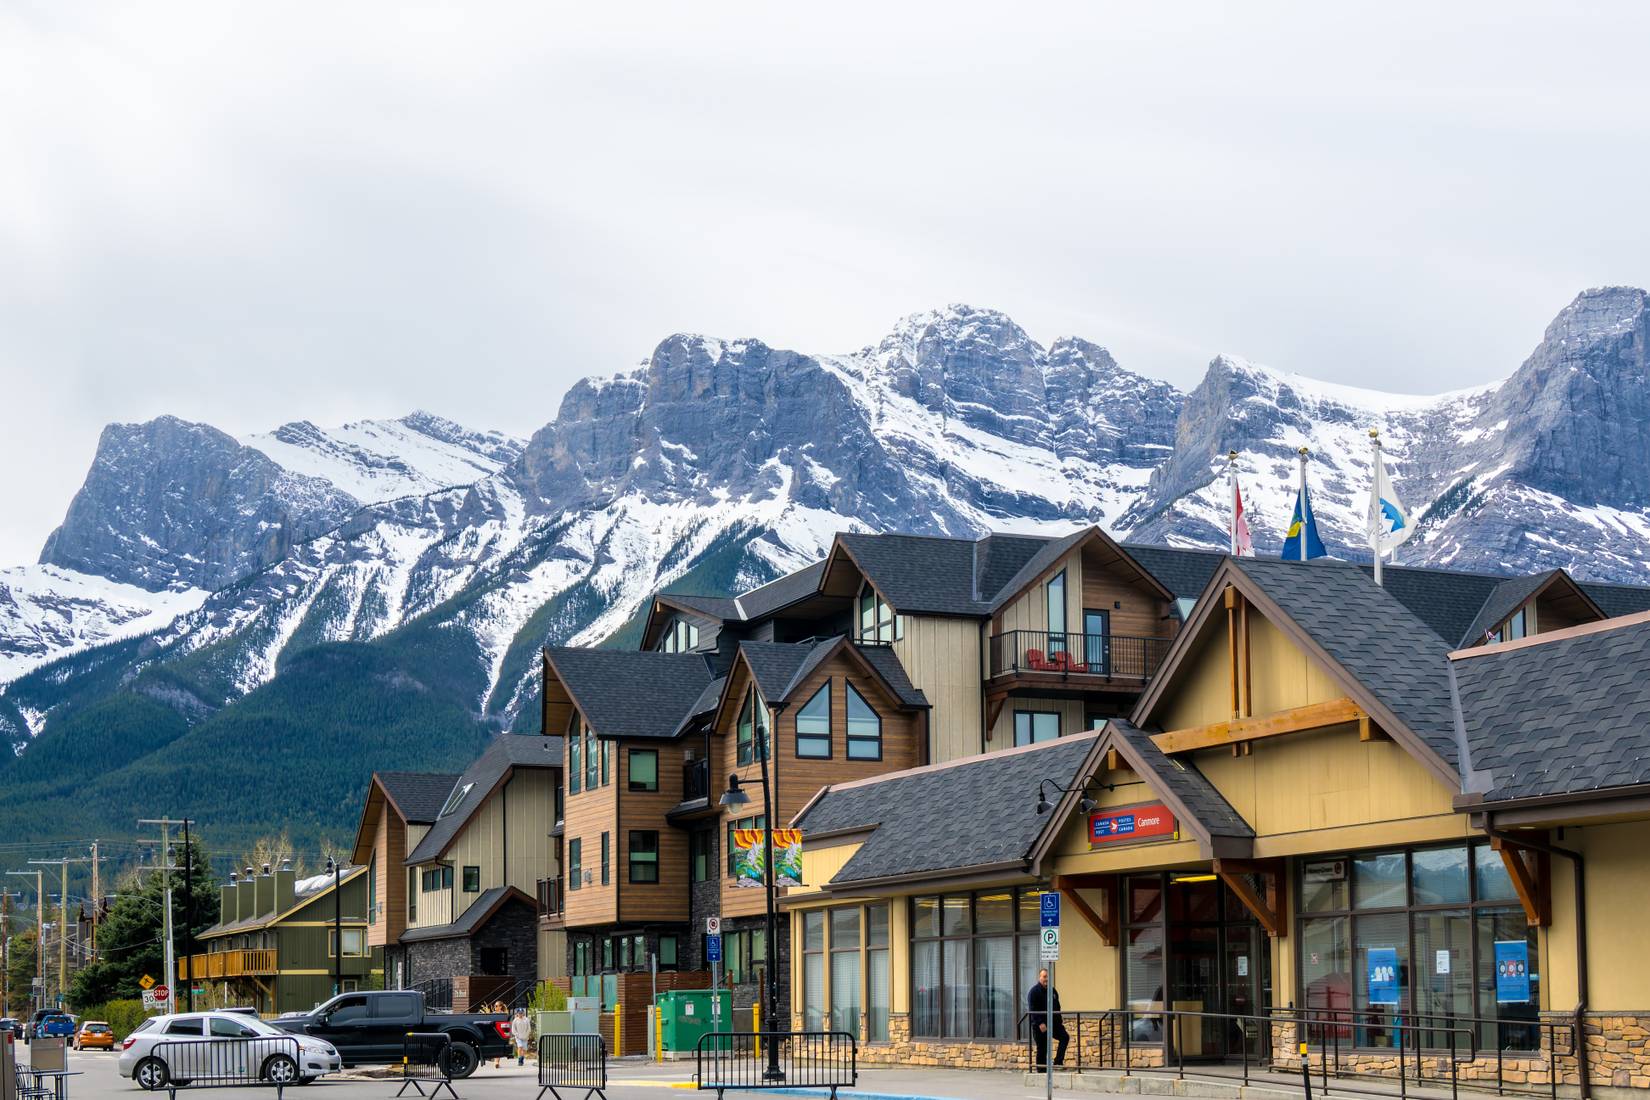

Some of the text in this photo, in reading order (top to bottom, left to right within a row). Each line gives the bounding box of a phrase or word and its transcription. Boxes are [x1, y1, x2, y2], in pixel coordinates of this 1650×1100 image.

[1137, 817, 1161, 828] Canmore
[1047, 933, 1054, 942] P
[144, 995, 154, 1003] 30
